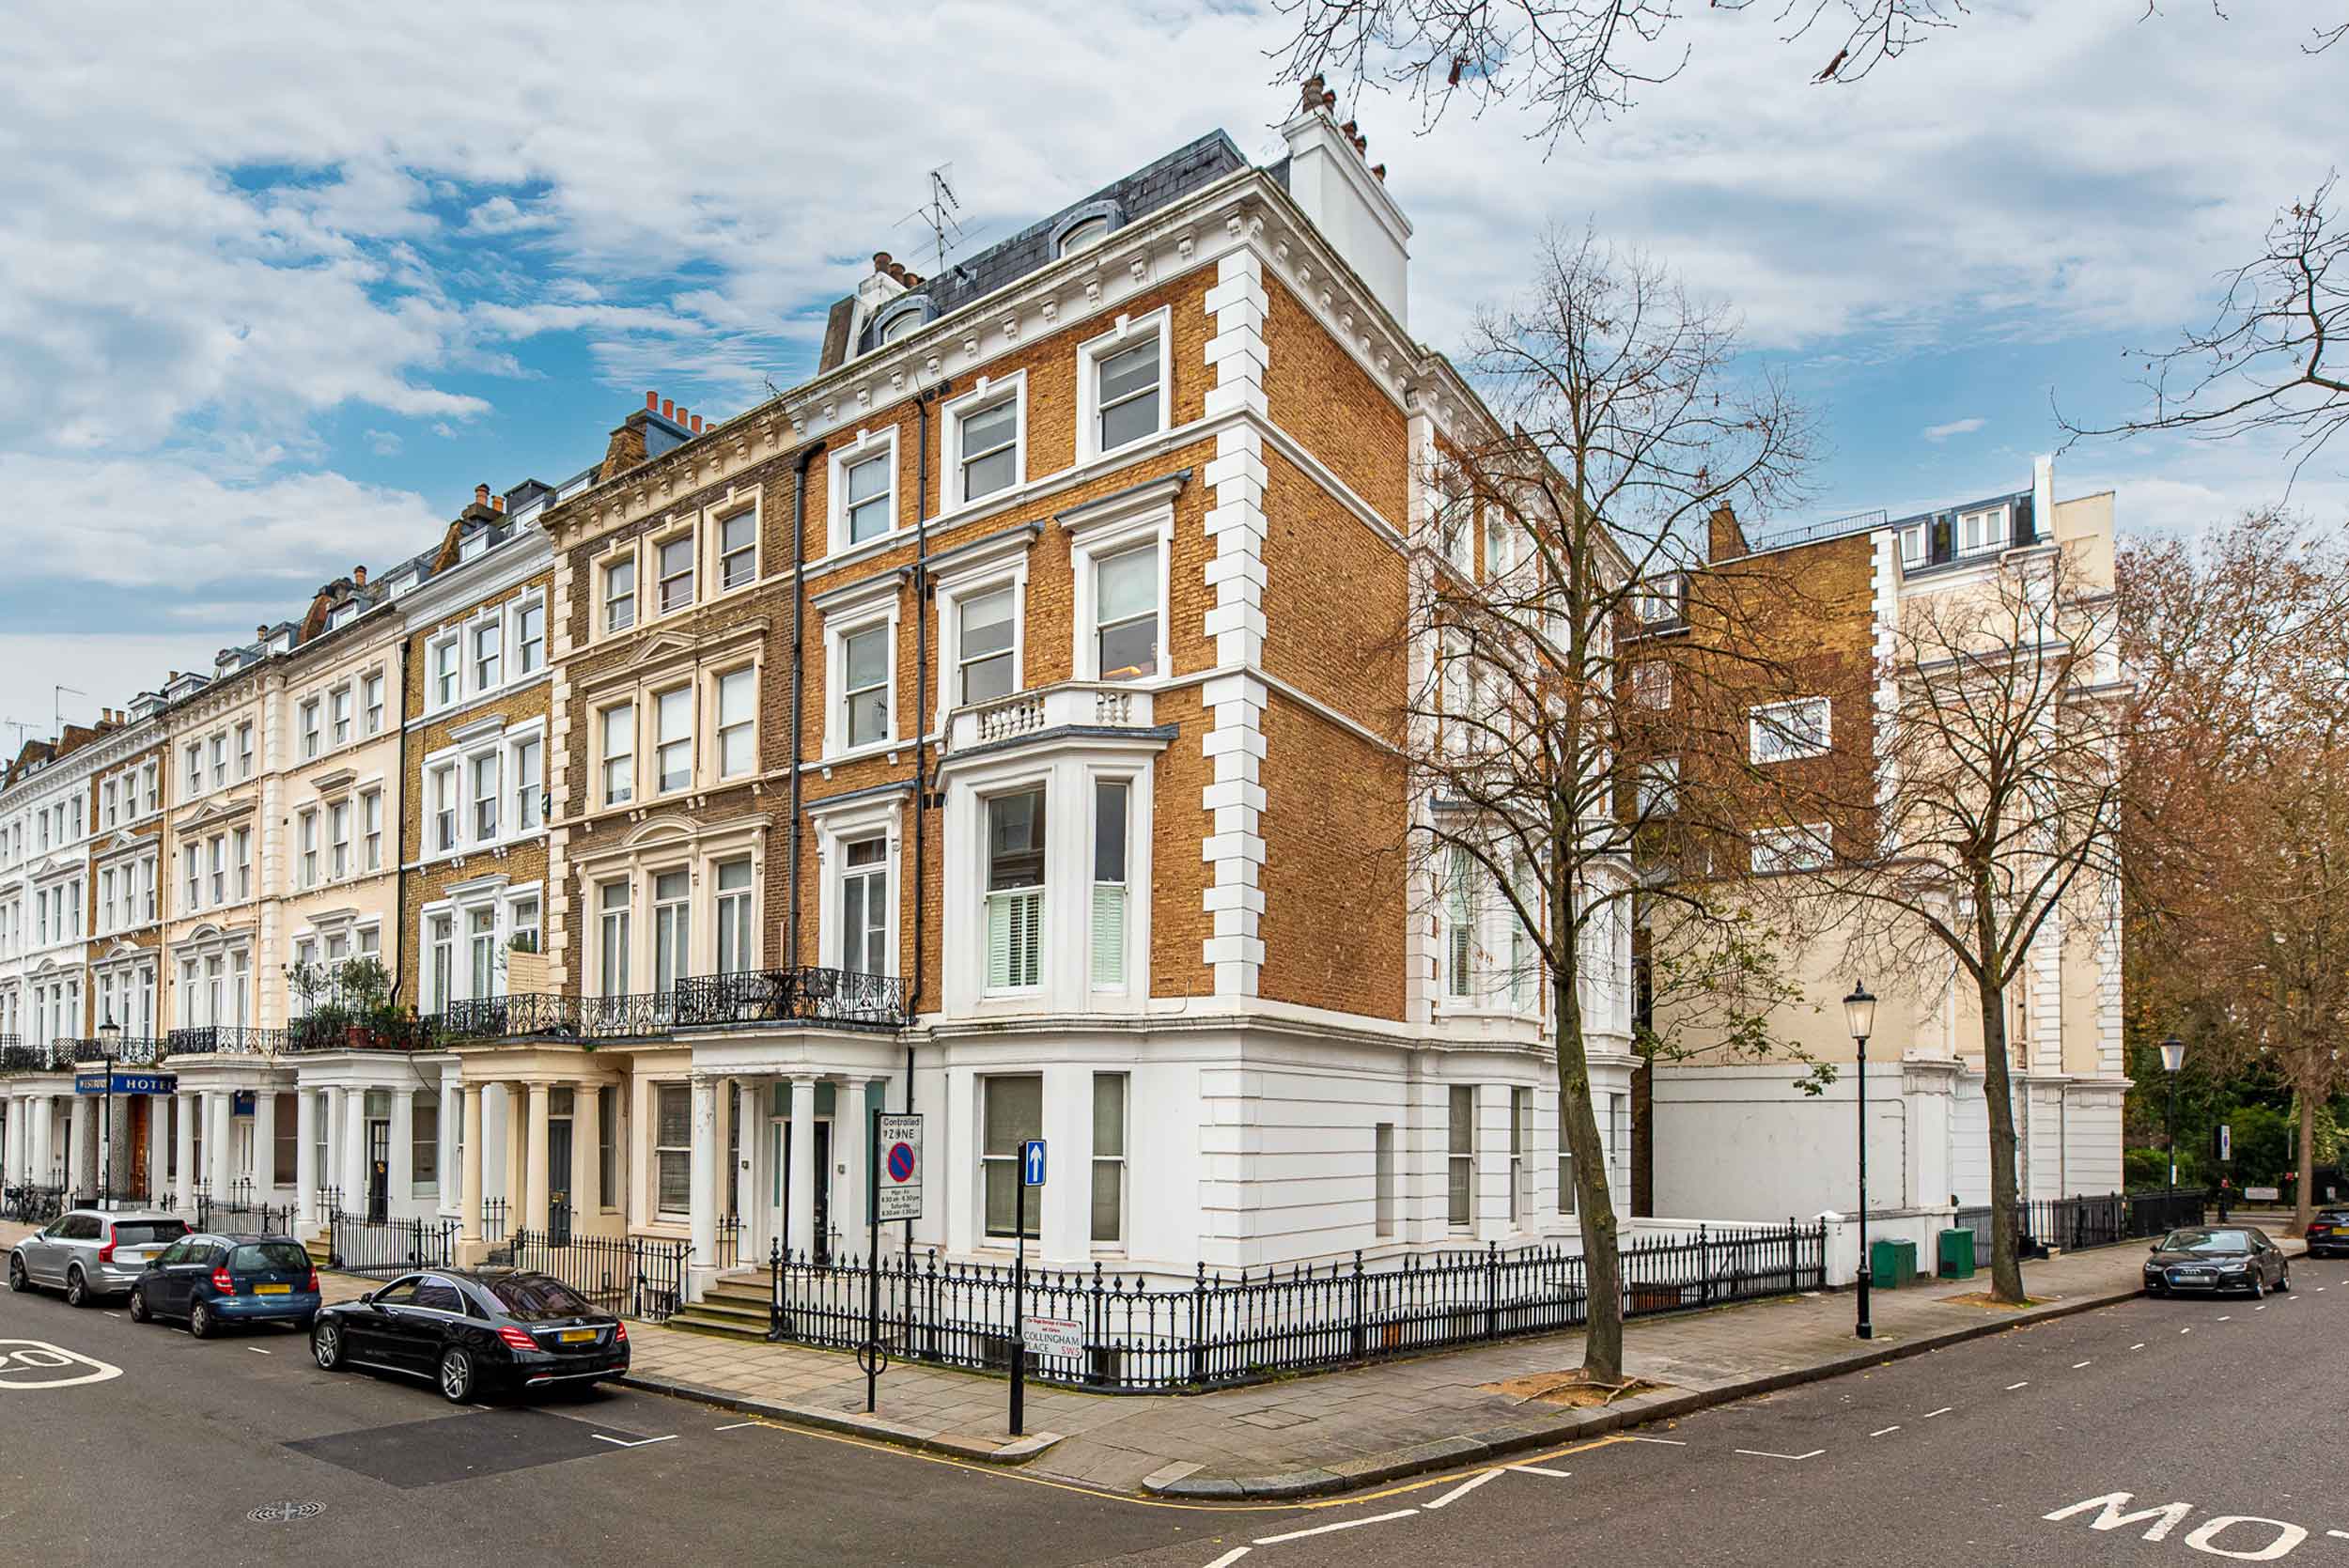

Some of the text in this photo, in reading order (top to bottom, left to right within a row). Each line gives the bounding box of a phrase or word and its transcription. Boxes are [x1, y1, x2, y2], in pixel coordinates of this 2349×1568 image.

[883, 1117, 919, 1126] Controlled
[889, 1128, 914, 1140] ZONE
[1023, 1330, 1080, 1346] COLLINGHAM
[1023, 1342, 1081, 1357] PLACE SW5
